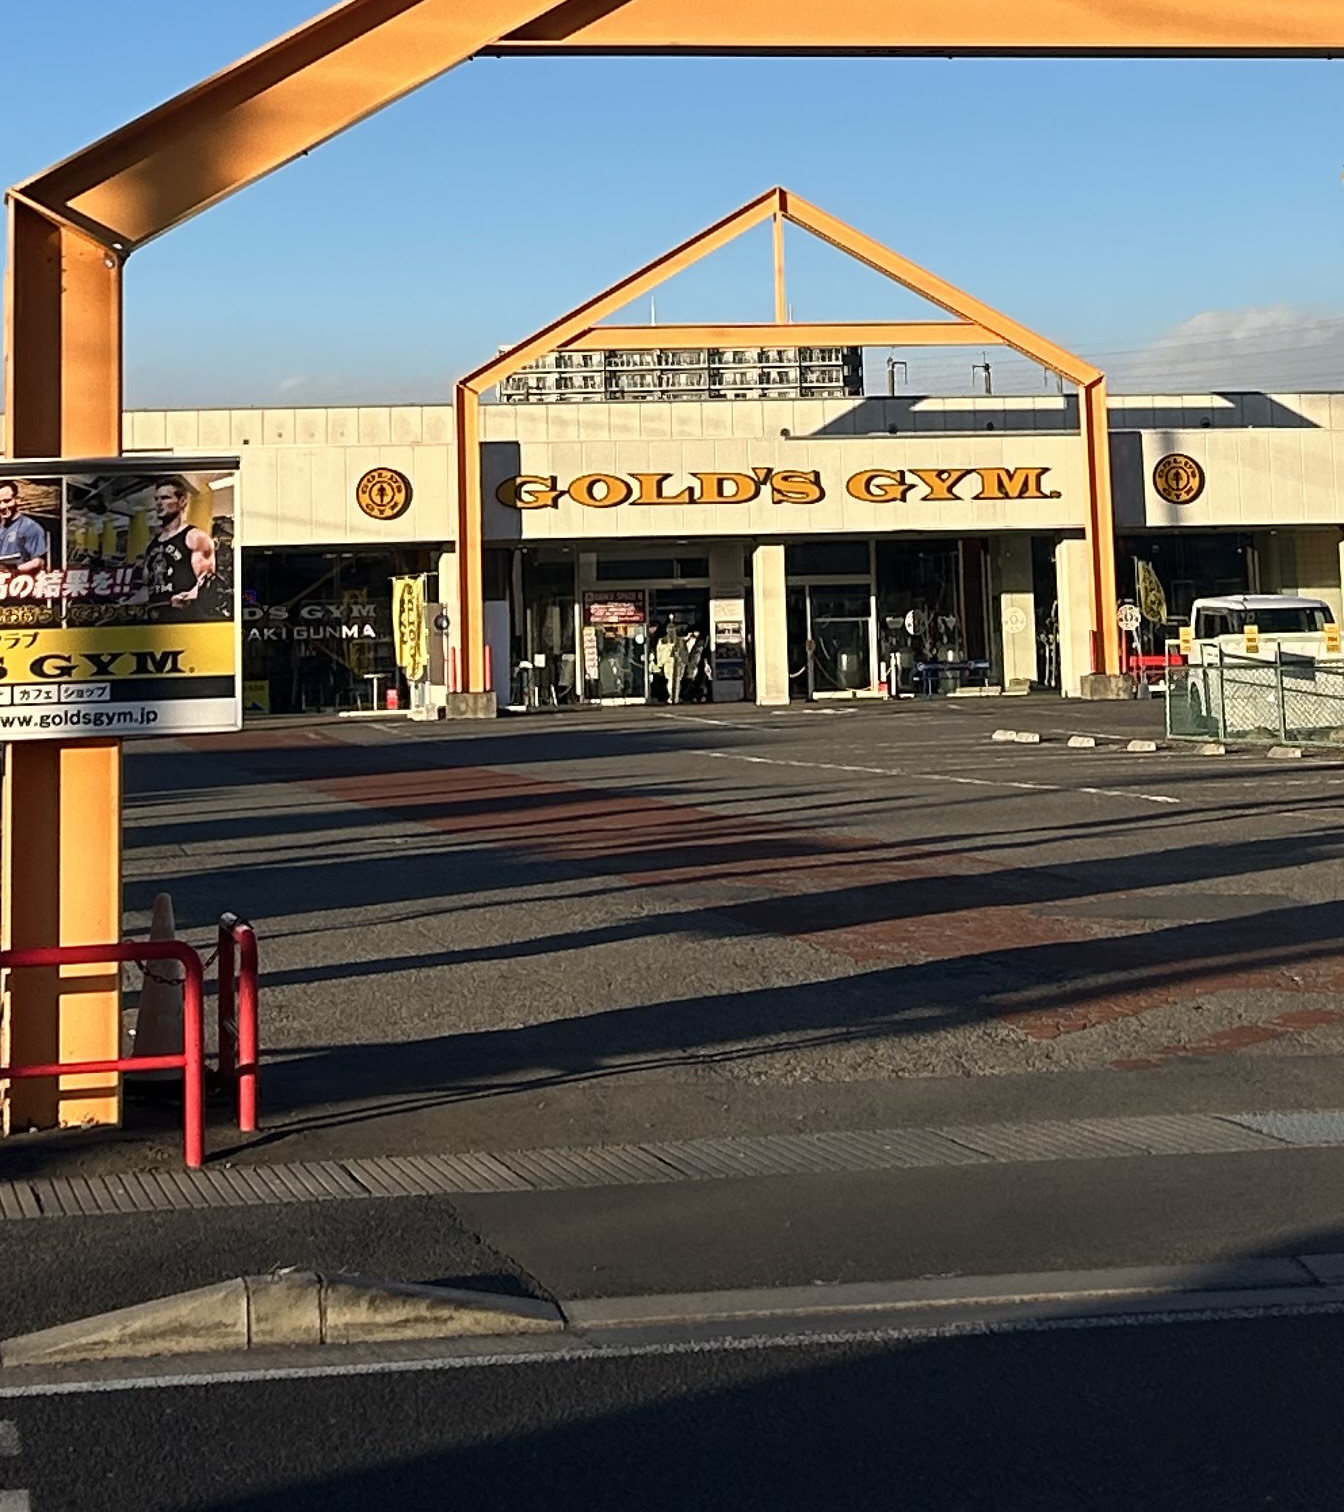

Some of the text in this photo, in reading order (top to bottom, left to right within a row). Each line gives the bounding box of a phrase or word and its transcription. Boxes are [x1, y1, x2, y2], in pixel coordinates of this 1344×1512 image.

[496, 467, 826, 510] GOLD'S
[300, 604, 378, 620] GYM
[293, 624, 376, 639] GUNMA
[29, 649, 186, 680] GYM
[19, 687, 54, 701] カフェ
